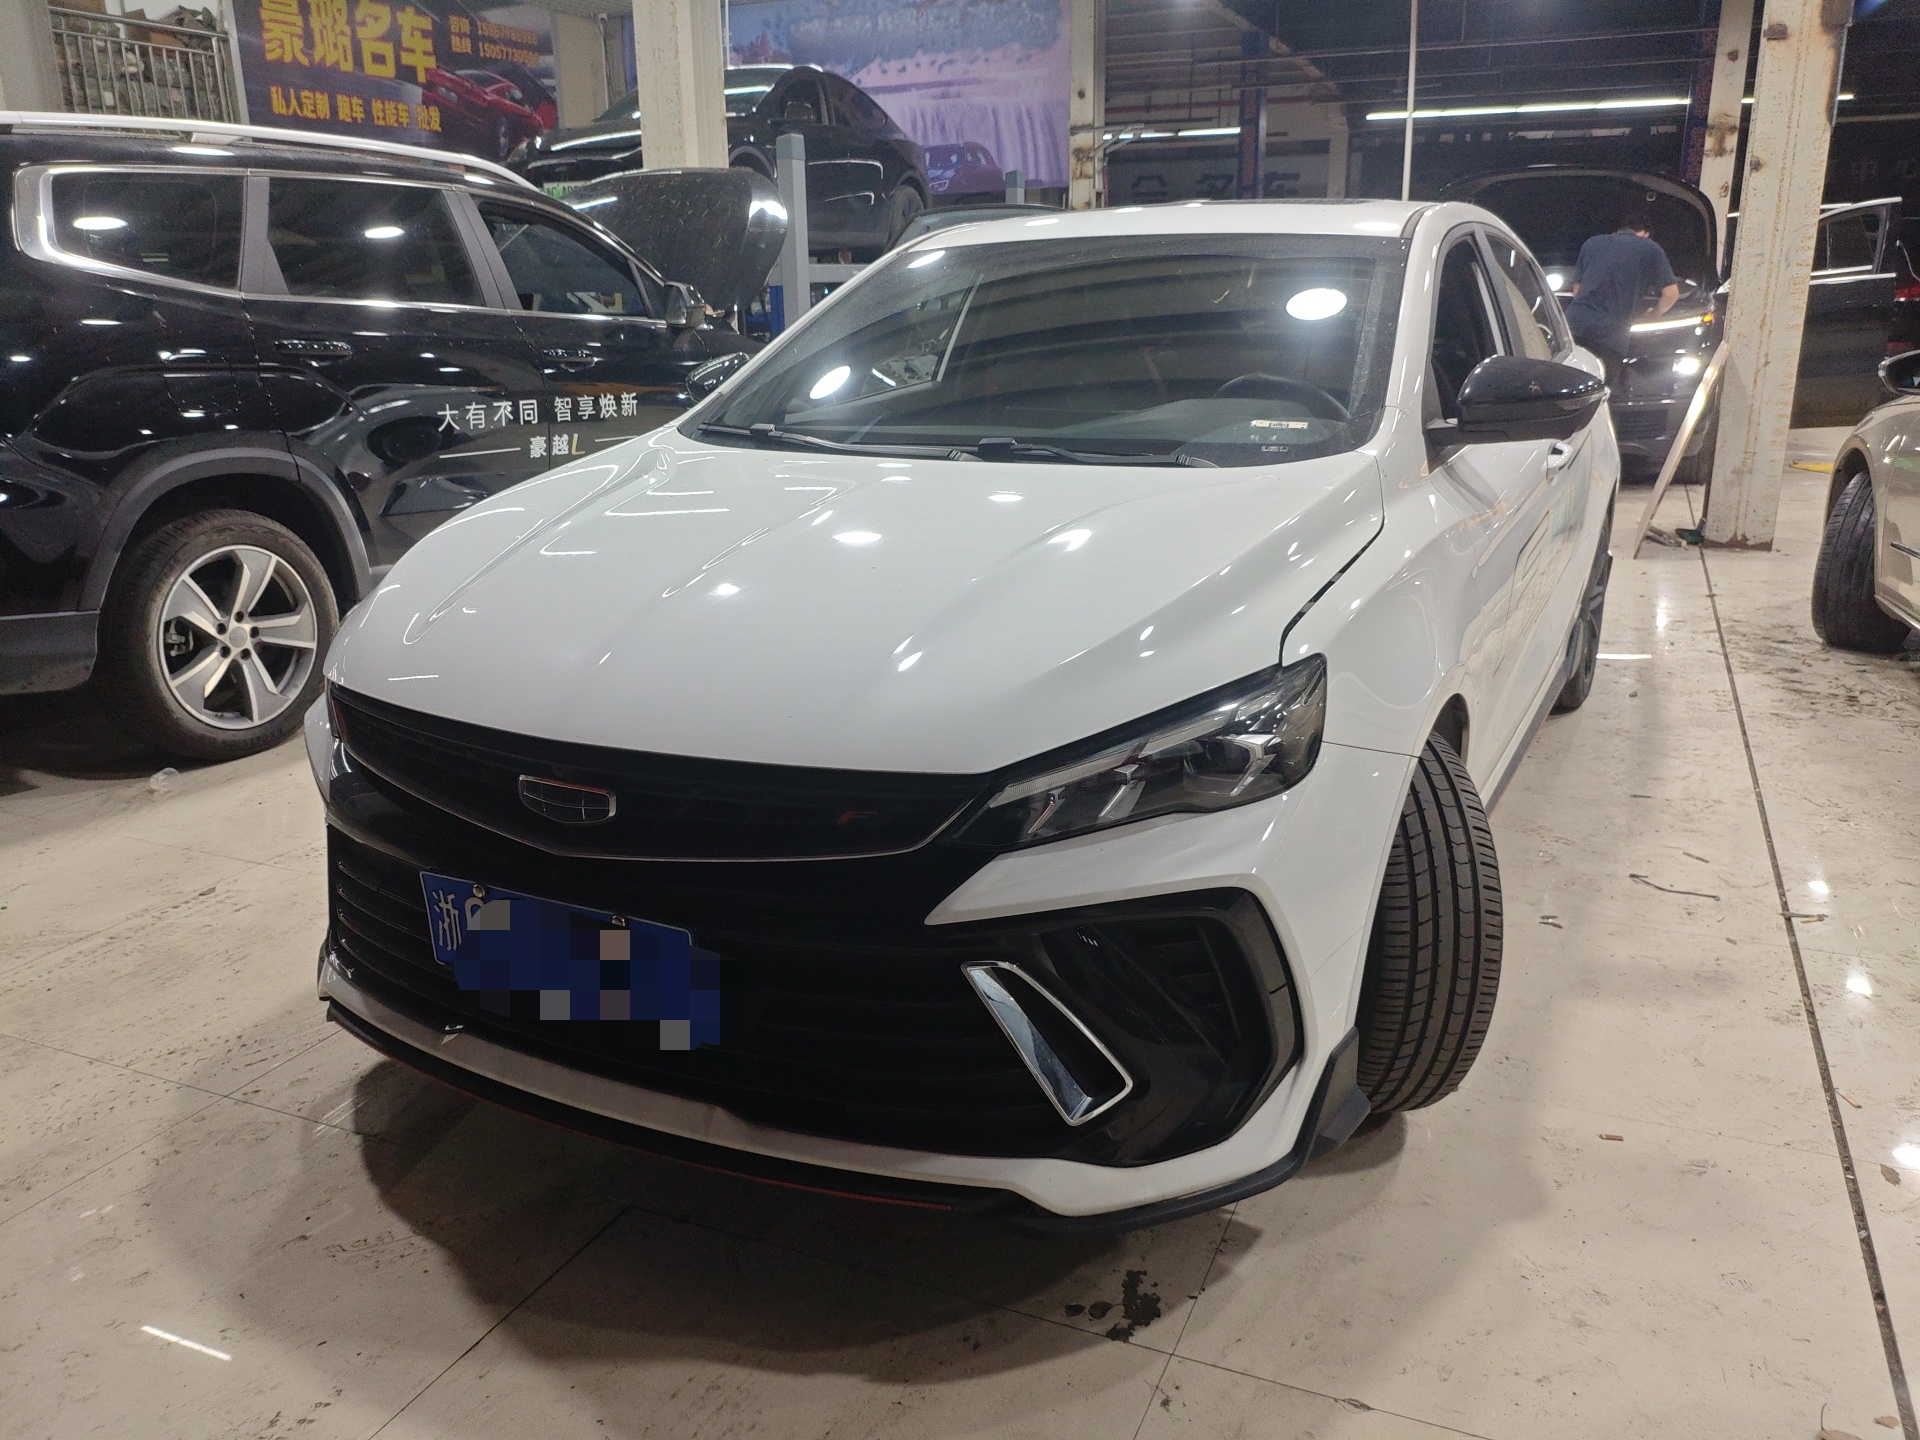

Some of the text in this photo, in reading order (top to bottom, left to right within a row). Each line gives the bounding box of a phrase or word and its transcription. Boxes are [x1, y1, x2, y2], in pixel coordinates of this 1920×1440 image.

[270, 85, 442, 133] 私人定制 跑车 性能车 批发
[437, 391, 638, 433] 大有不同 智享焕新
